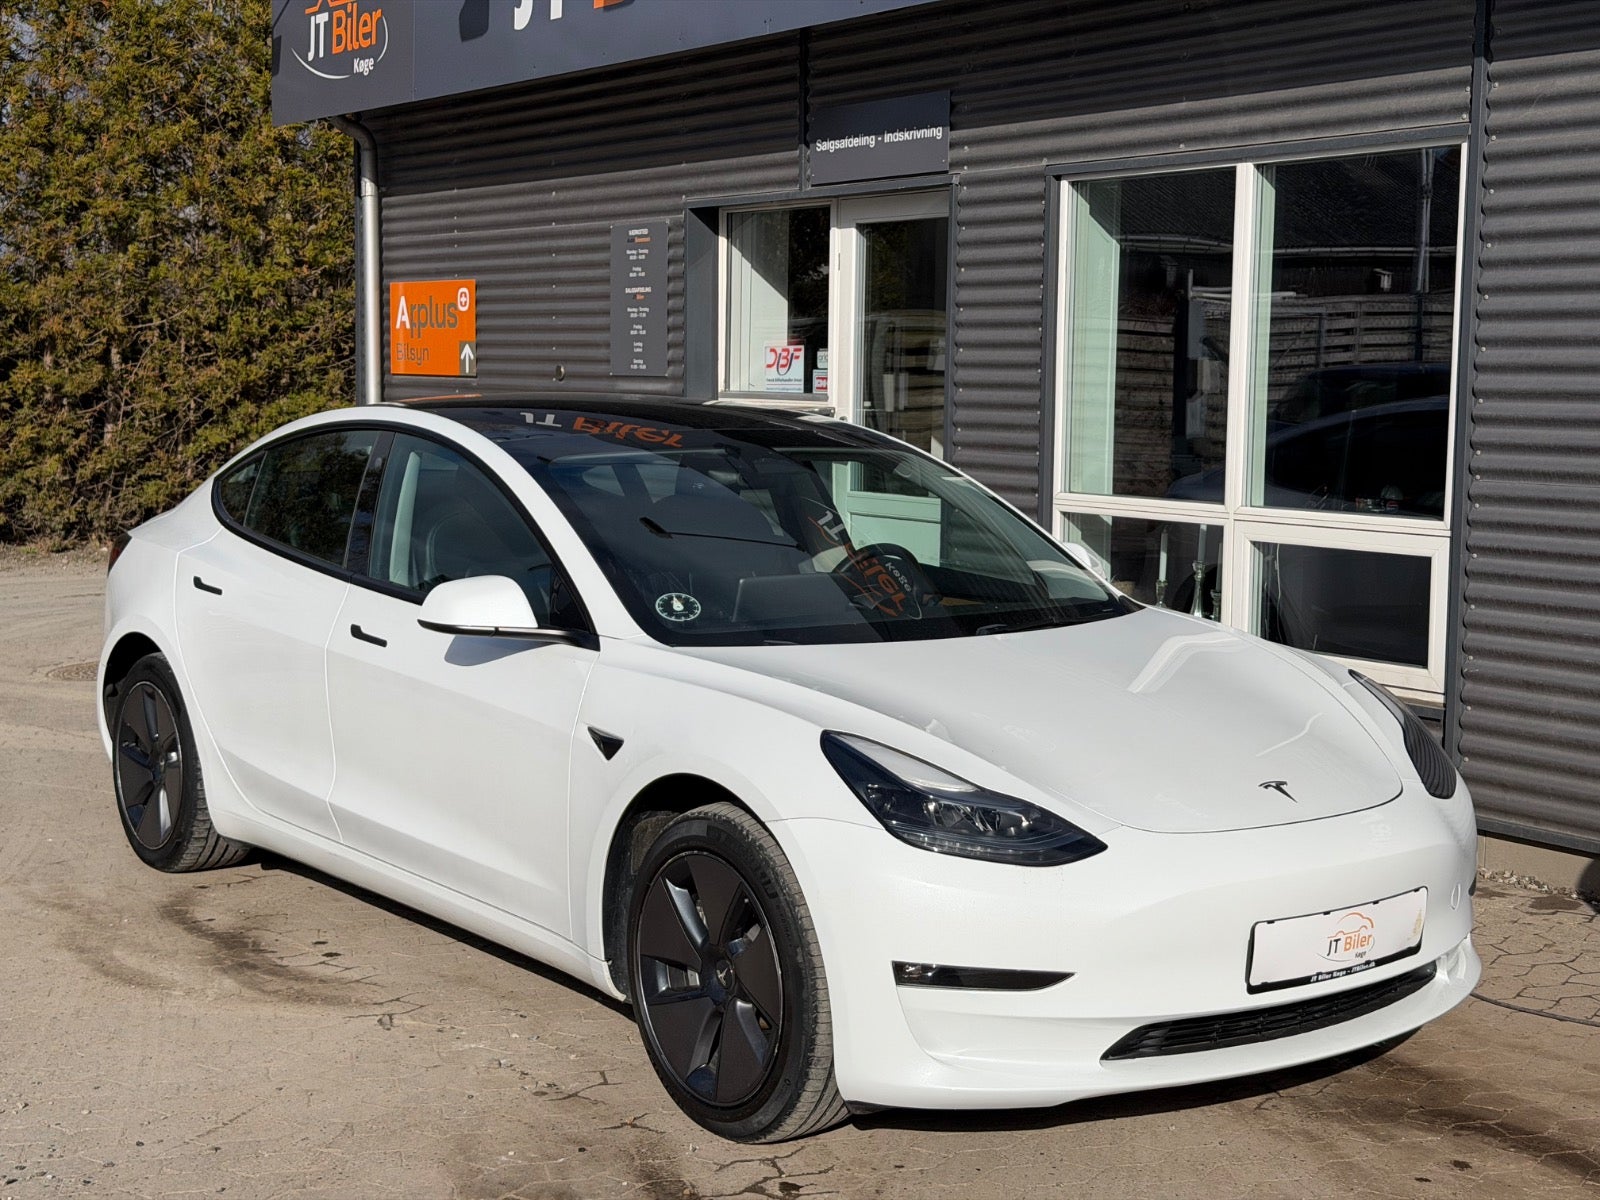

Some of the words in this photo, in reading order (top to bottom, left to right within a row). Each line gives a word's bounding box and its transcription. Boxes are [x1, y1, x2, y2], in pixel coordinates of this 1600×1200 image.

[308, 12, 329, 61] JT
[332, 2, 383, 54] Biler
[353, 57, 374, 76] Køge
[815, 134, 876, 153] Salgsafdeling
[884, 125, 943, 143] Indskrivning
[396, 343, 429, 366] Bilsyn
[1326, 938, 1341, 956] JT
[1343, 933, 1372, 952] Biler
